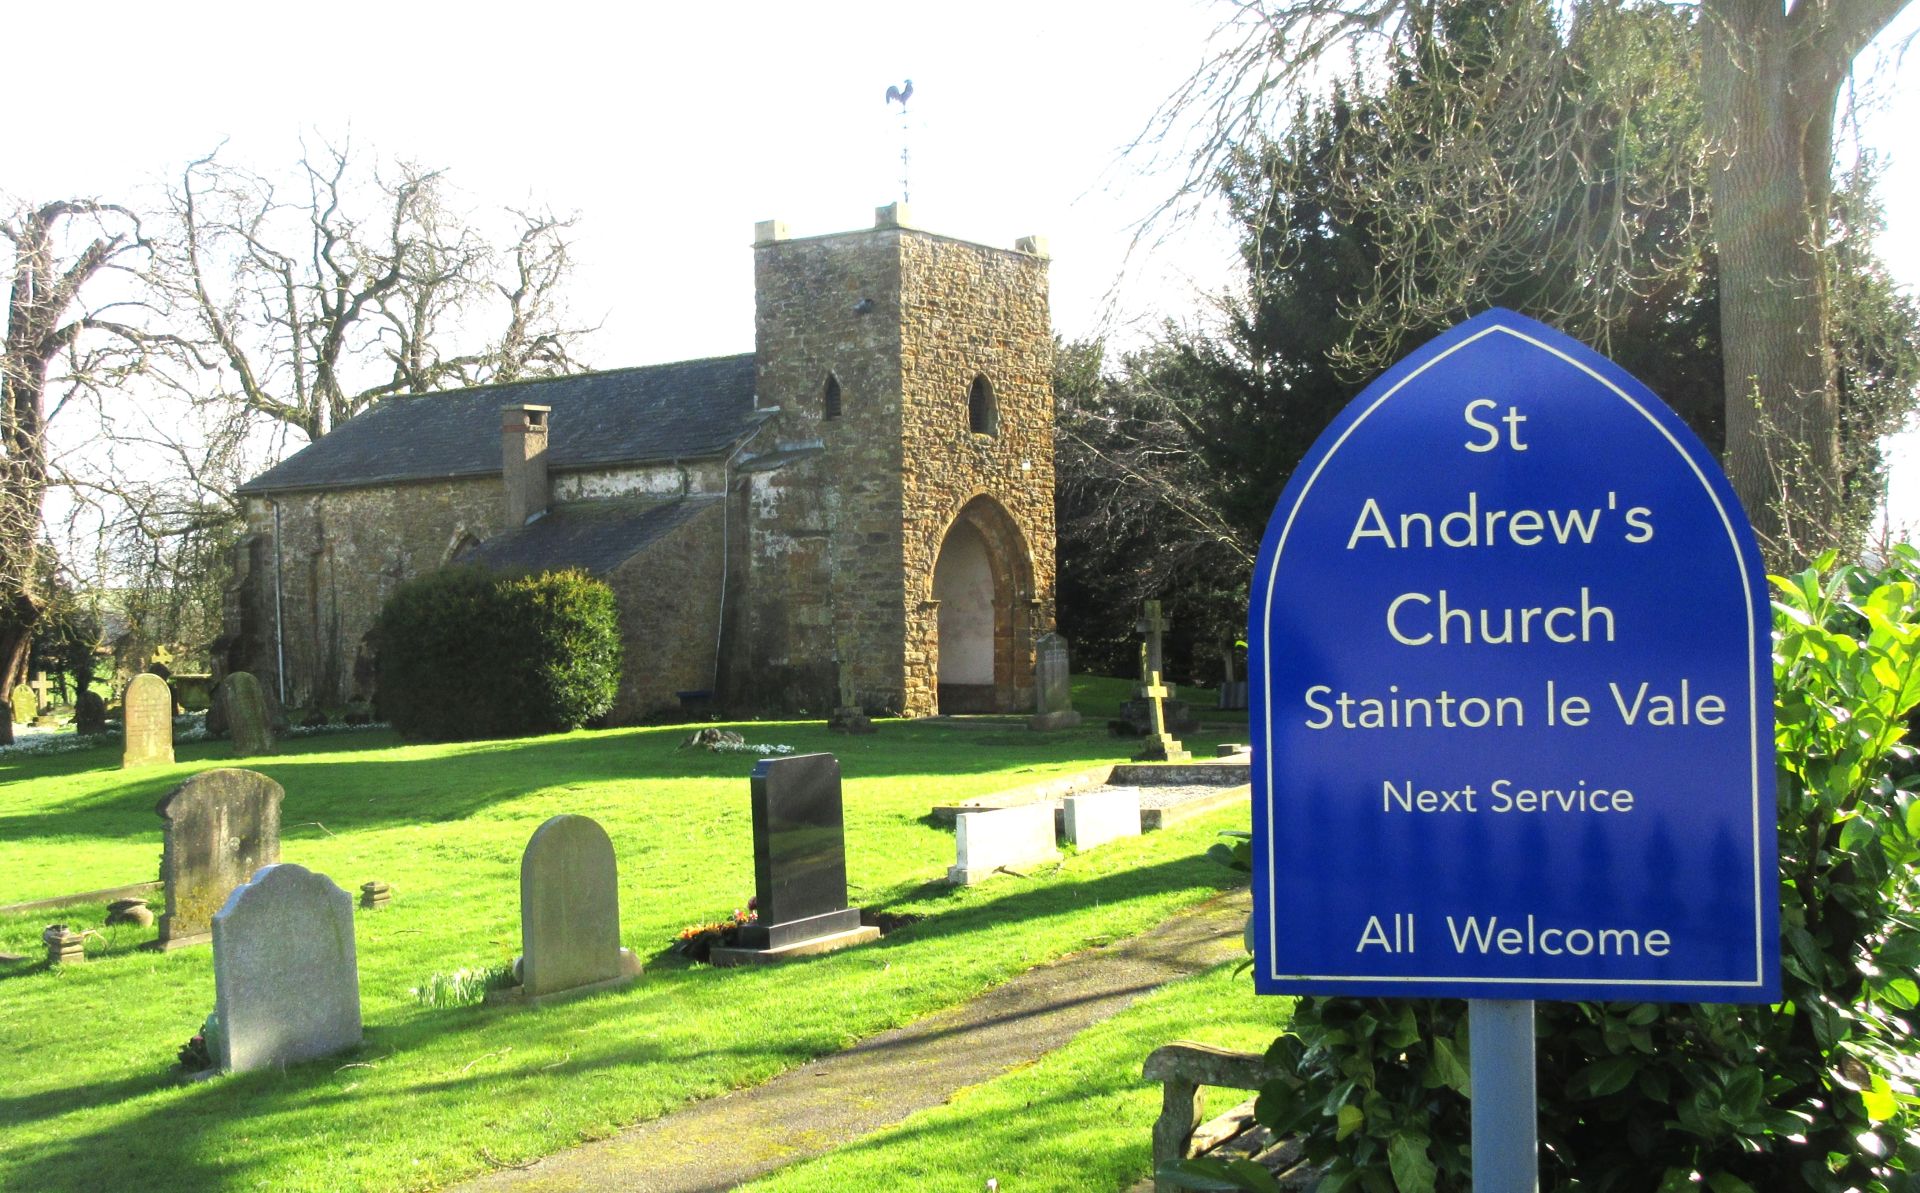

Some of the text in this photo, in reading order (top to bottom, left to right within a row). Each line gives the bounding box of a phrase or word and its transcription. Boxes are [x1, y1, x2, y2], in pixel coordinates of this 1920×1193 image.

[1464, 398, 1528, 453] St
[1346, 491, 1654, 550] Andrew's
[1386, 586, 1615, 646] Church
[1305, 678, 1726, 730] Stainton le Vale
[1383, 779, 1634, 813] Next Service
[1356, 913, 1671, 957] All Welcome
